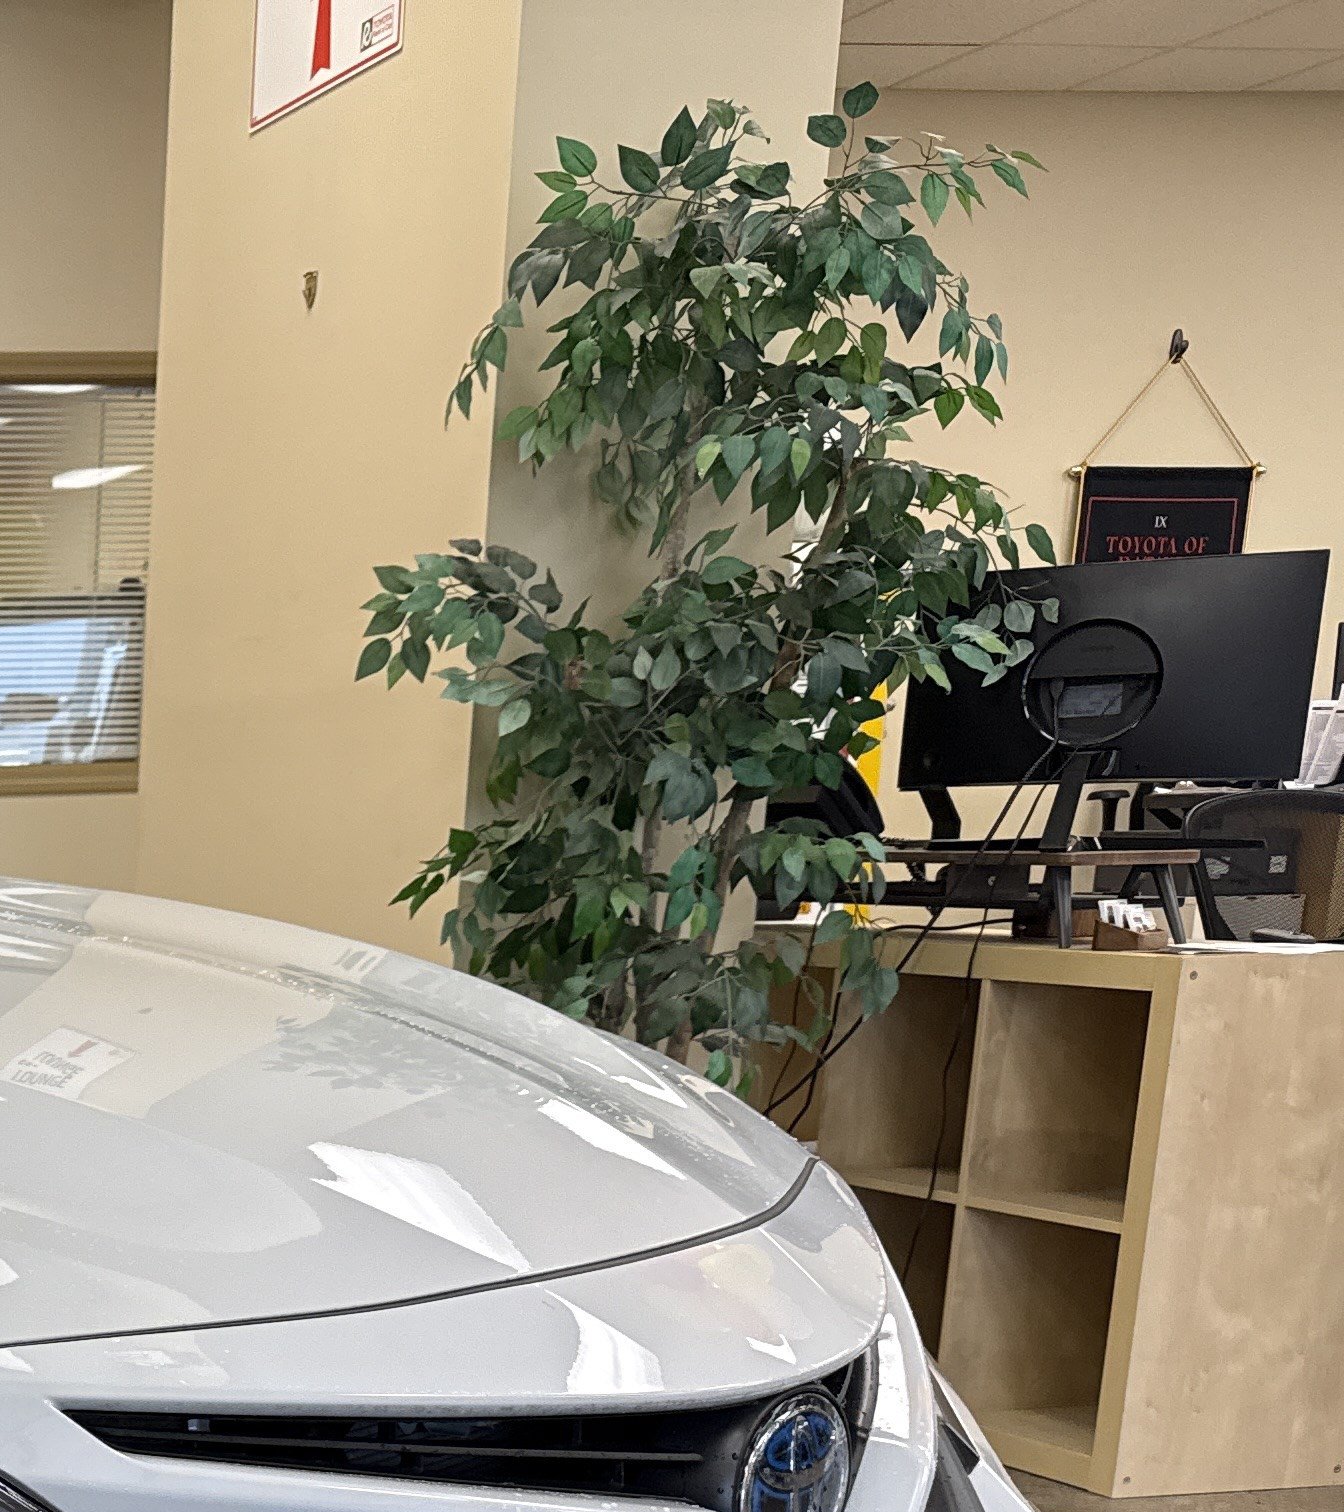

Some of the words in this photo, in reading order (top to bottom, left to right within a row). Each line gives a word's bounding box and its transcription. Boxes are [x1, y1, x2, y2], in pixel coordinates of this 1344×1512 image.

[1154, 515, 1169, 529] IX
[1106, 536, 1178, 554] TOYOTA
[1184, 536, 1210, 554] OF
